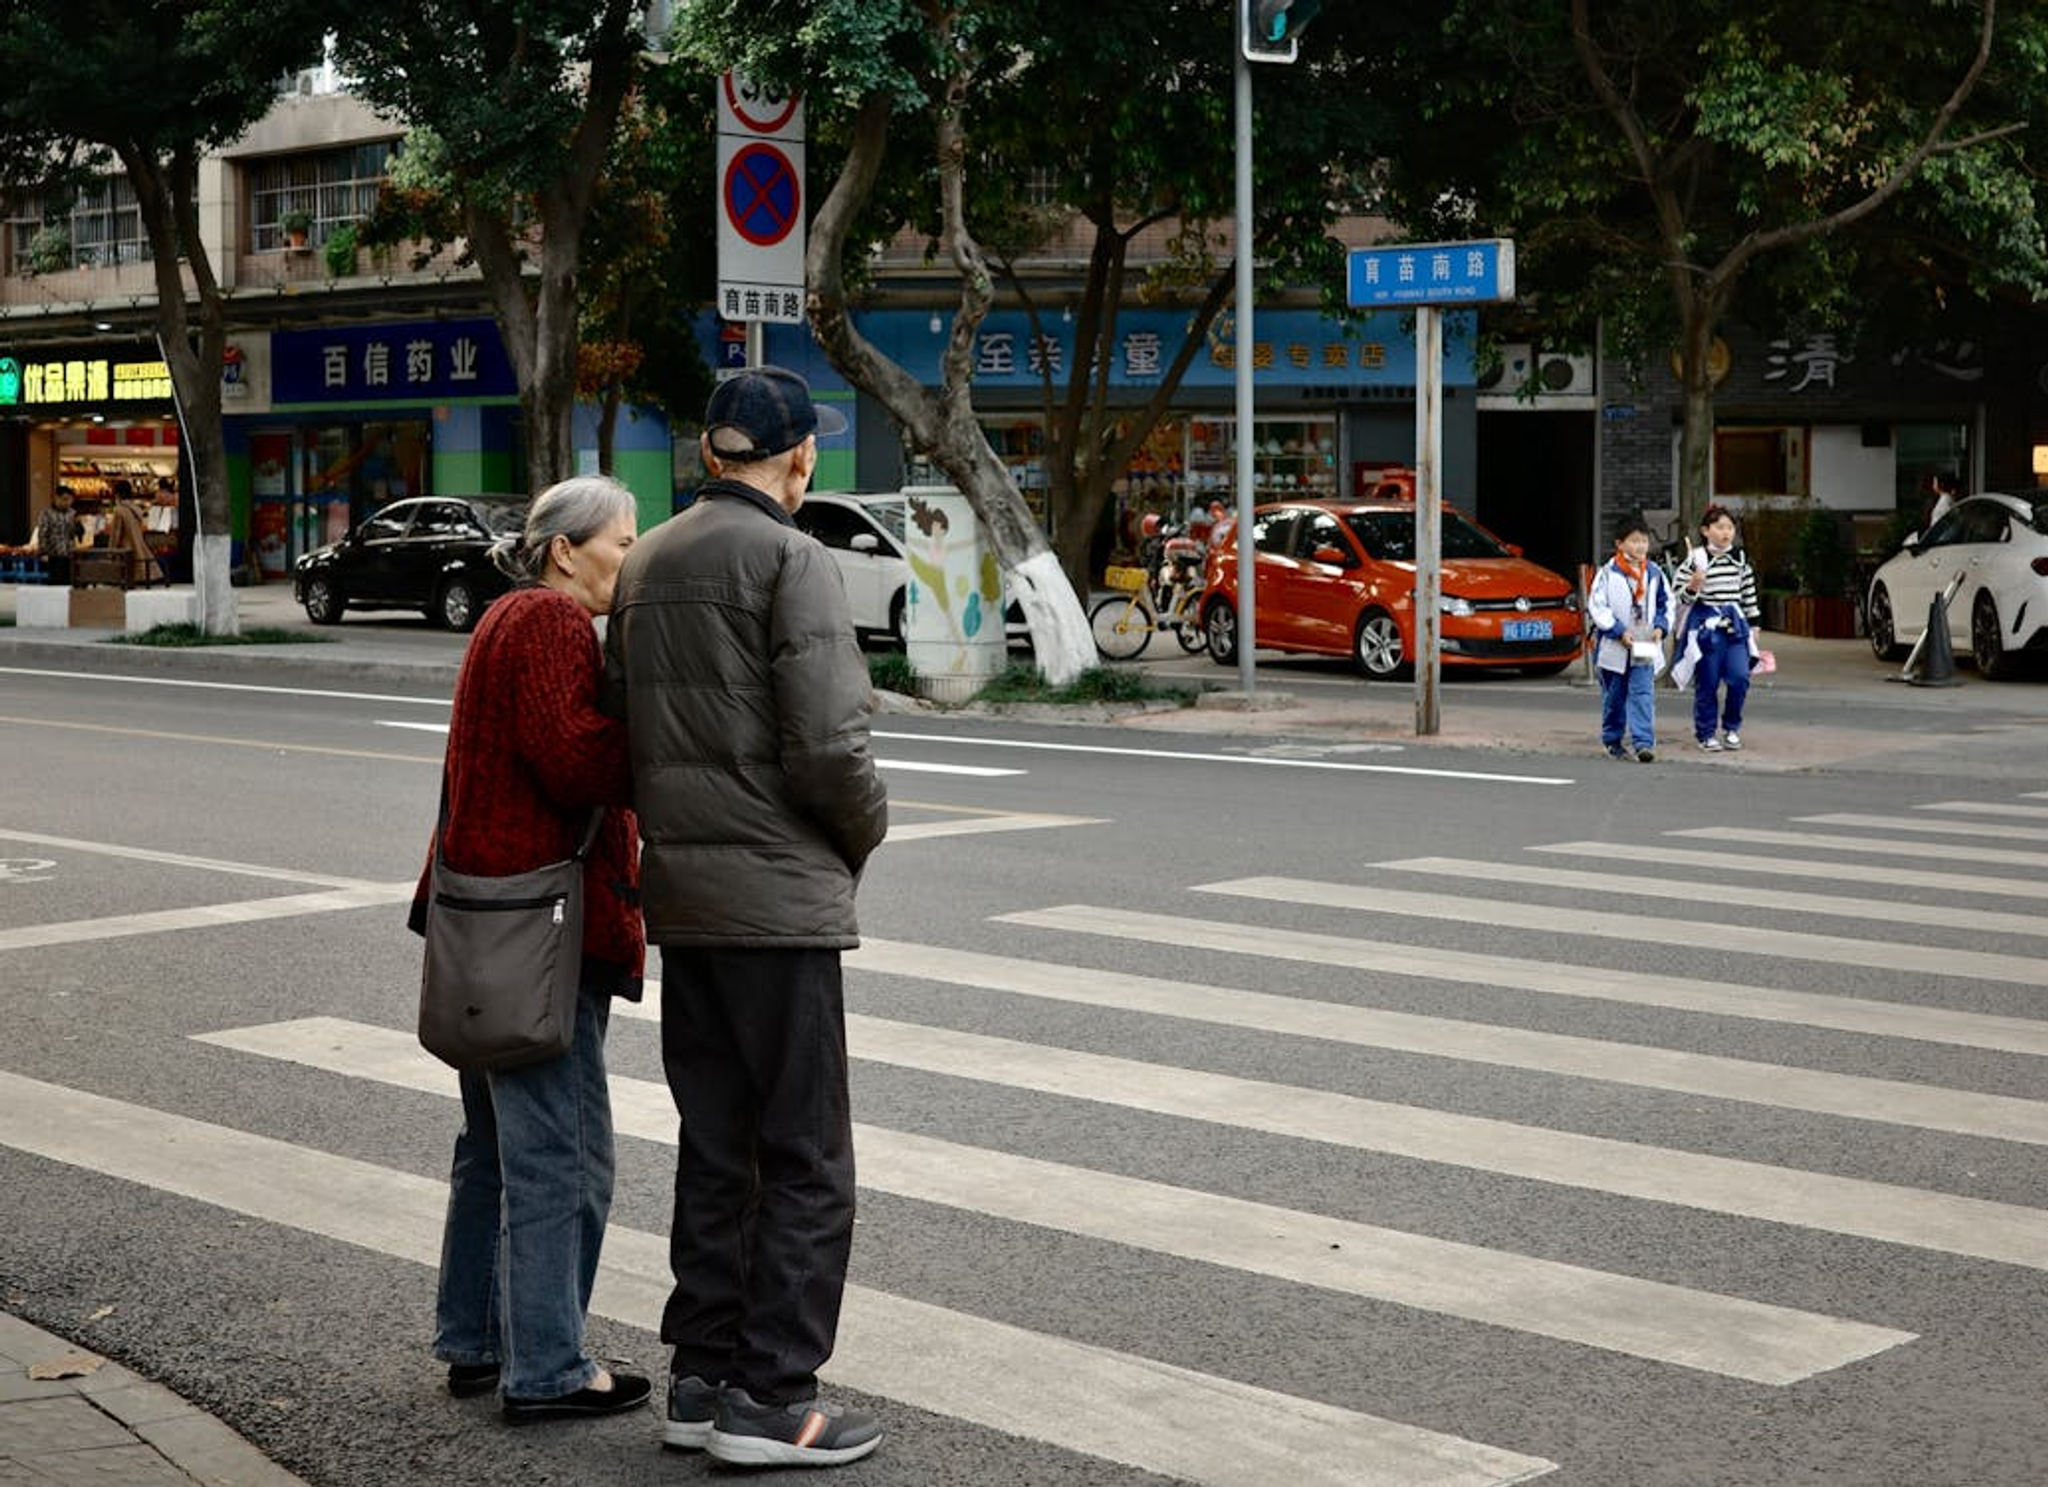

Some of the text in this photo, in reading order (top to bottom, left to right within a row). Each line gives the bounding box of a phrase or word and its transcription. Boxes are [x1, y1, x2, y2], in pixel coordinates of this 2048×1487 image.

[1364, 251, 1485, 285] 育苗南路
[724, 288, 799, 317] 育苗南路
[323, 338, 477, 387] 百信药业
